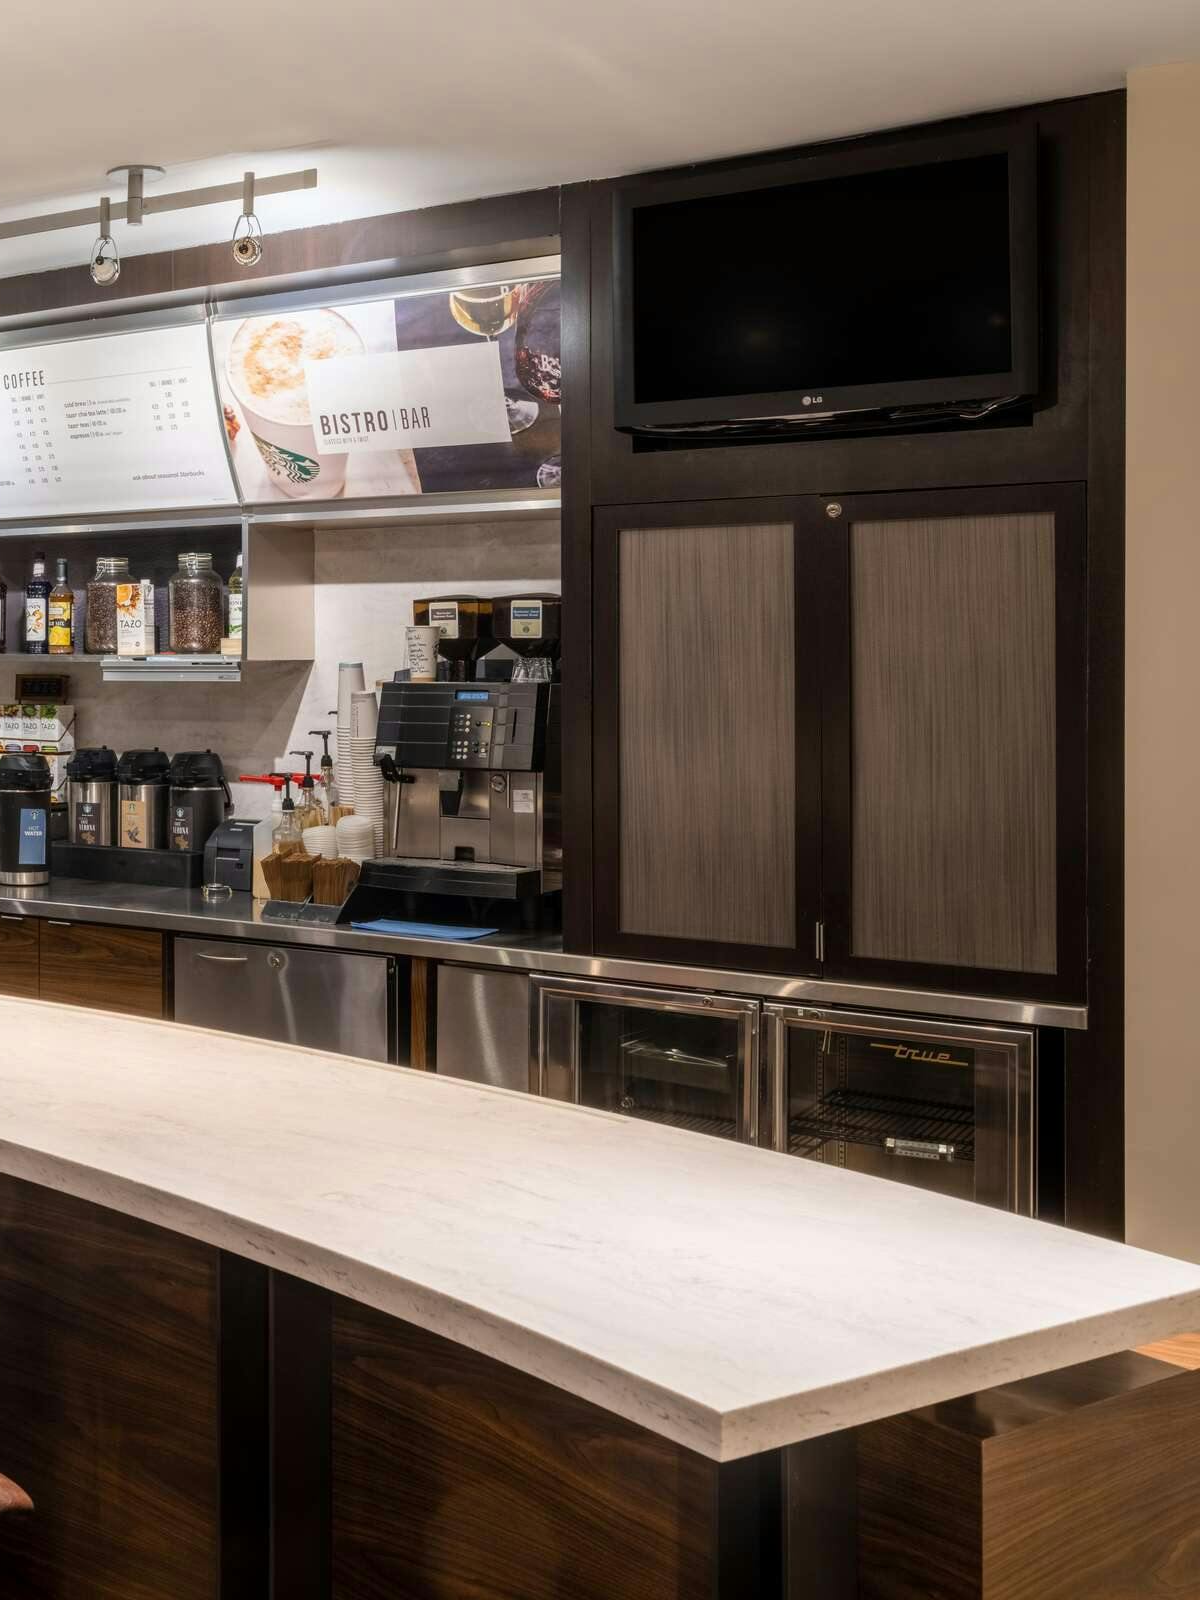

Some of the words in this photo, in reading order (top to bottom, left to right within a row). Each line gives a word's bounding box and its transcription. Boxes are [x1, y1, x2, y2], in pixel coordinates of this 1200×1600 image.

[3, 370, 45, 391] COFFEE
[320, 410, 389, 436] BISTRO
[400, 406, 431, 430] BAR
[119, 619, 142, 629] TAZO
